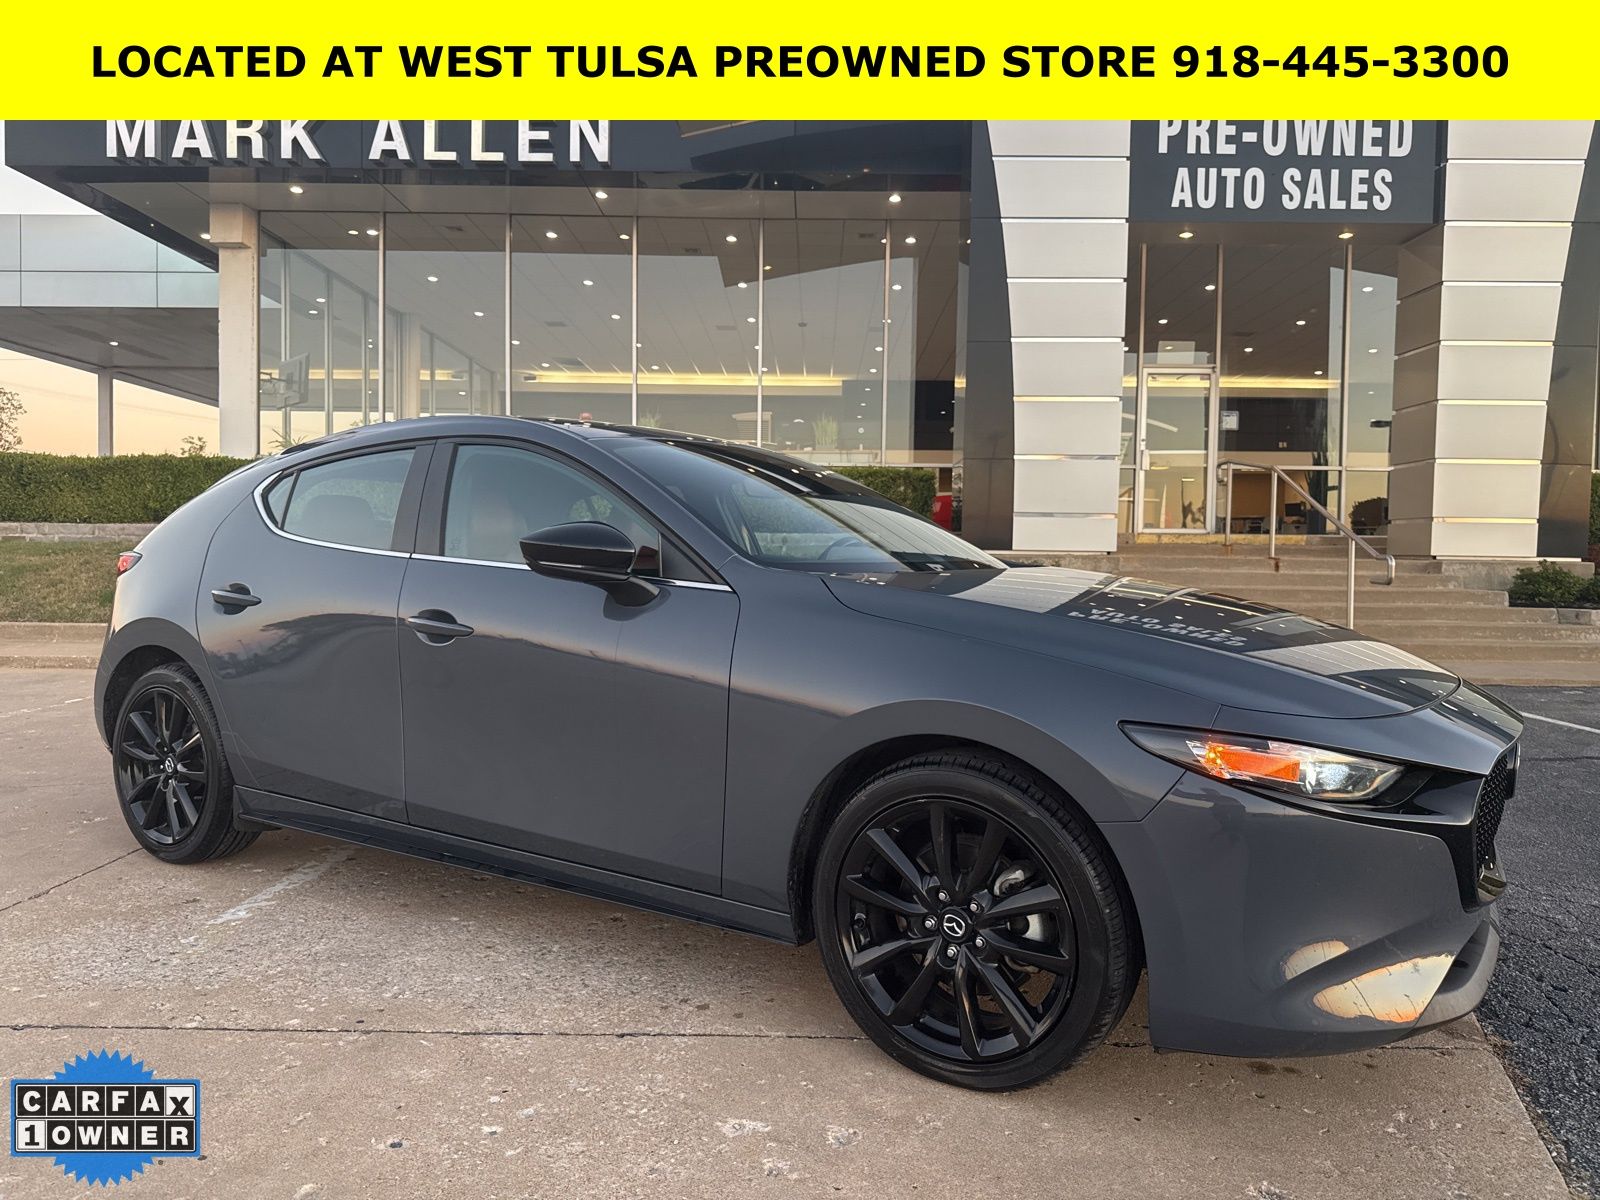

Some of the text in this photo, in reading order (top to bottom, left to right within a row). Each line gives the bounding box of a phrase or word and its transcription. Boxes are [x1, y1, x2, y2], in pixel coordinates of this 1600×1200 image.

[106, 120, 610, 163] MARK ALLEN
[1158, 120, 1413, 157] PRE-OWNED
[1171, 167, 1393, 211] AUTO SALES
